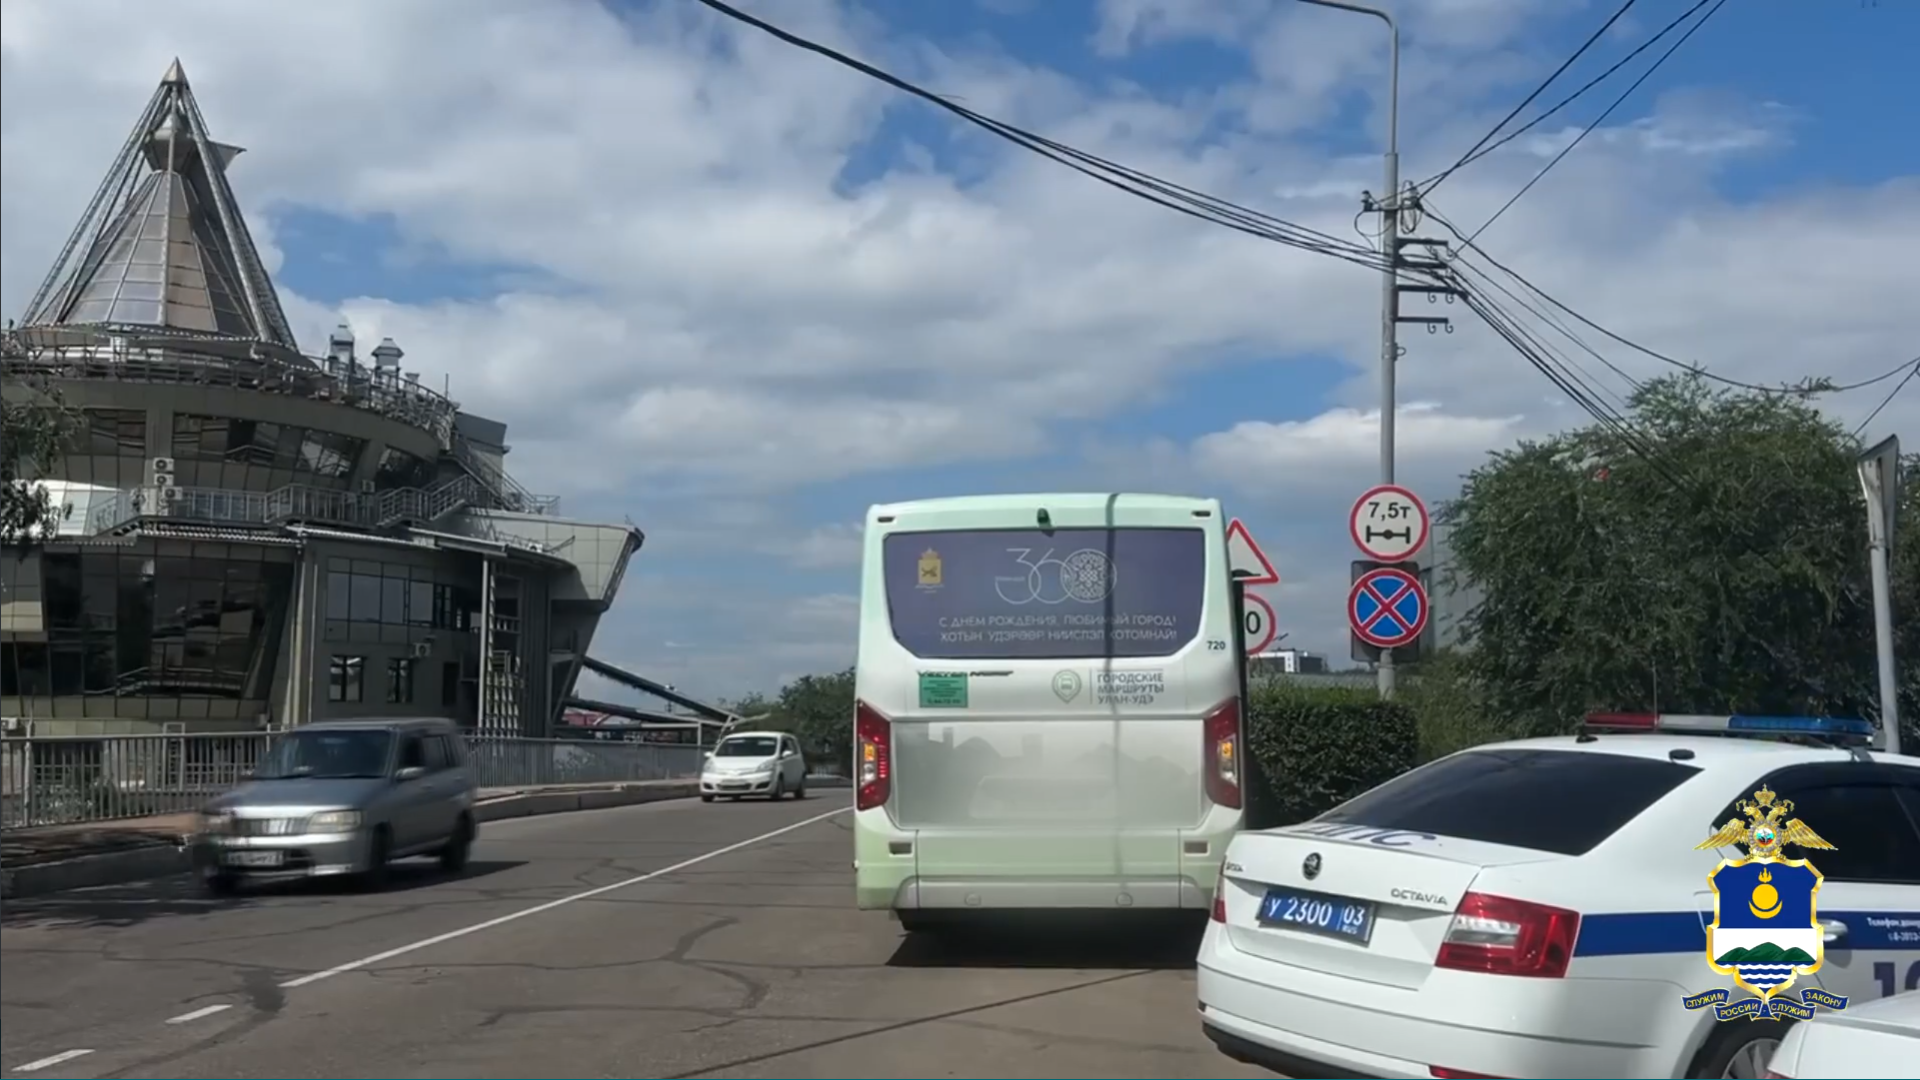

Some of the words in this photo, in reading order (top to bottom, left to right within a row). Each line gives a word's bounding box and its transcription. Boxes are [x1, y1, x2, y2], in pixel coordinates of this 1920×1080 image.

[938, 616, 948, 628] С
[1132, 614, 1176, 626] ГОРОД!
[1246, 611, 1261, 635] 0
[1207, 641, 1226, 650] 720
[1097, 672, 1164, 684] ГОРОДСКИЕ
[1097, 683, 1165, 694] МАРШРУТЫ
[1098, 694, 1155, 705] УЛАН-УДЭ
[1391, 888, 1448, 906] OCTAVIA
[1283, 897, 1333, 926] 2300
[1343, 905, 1365, 926] 03
